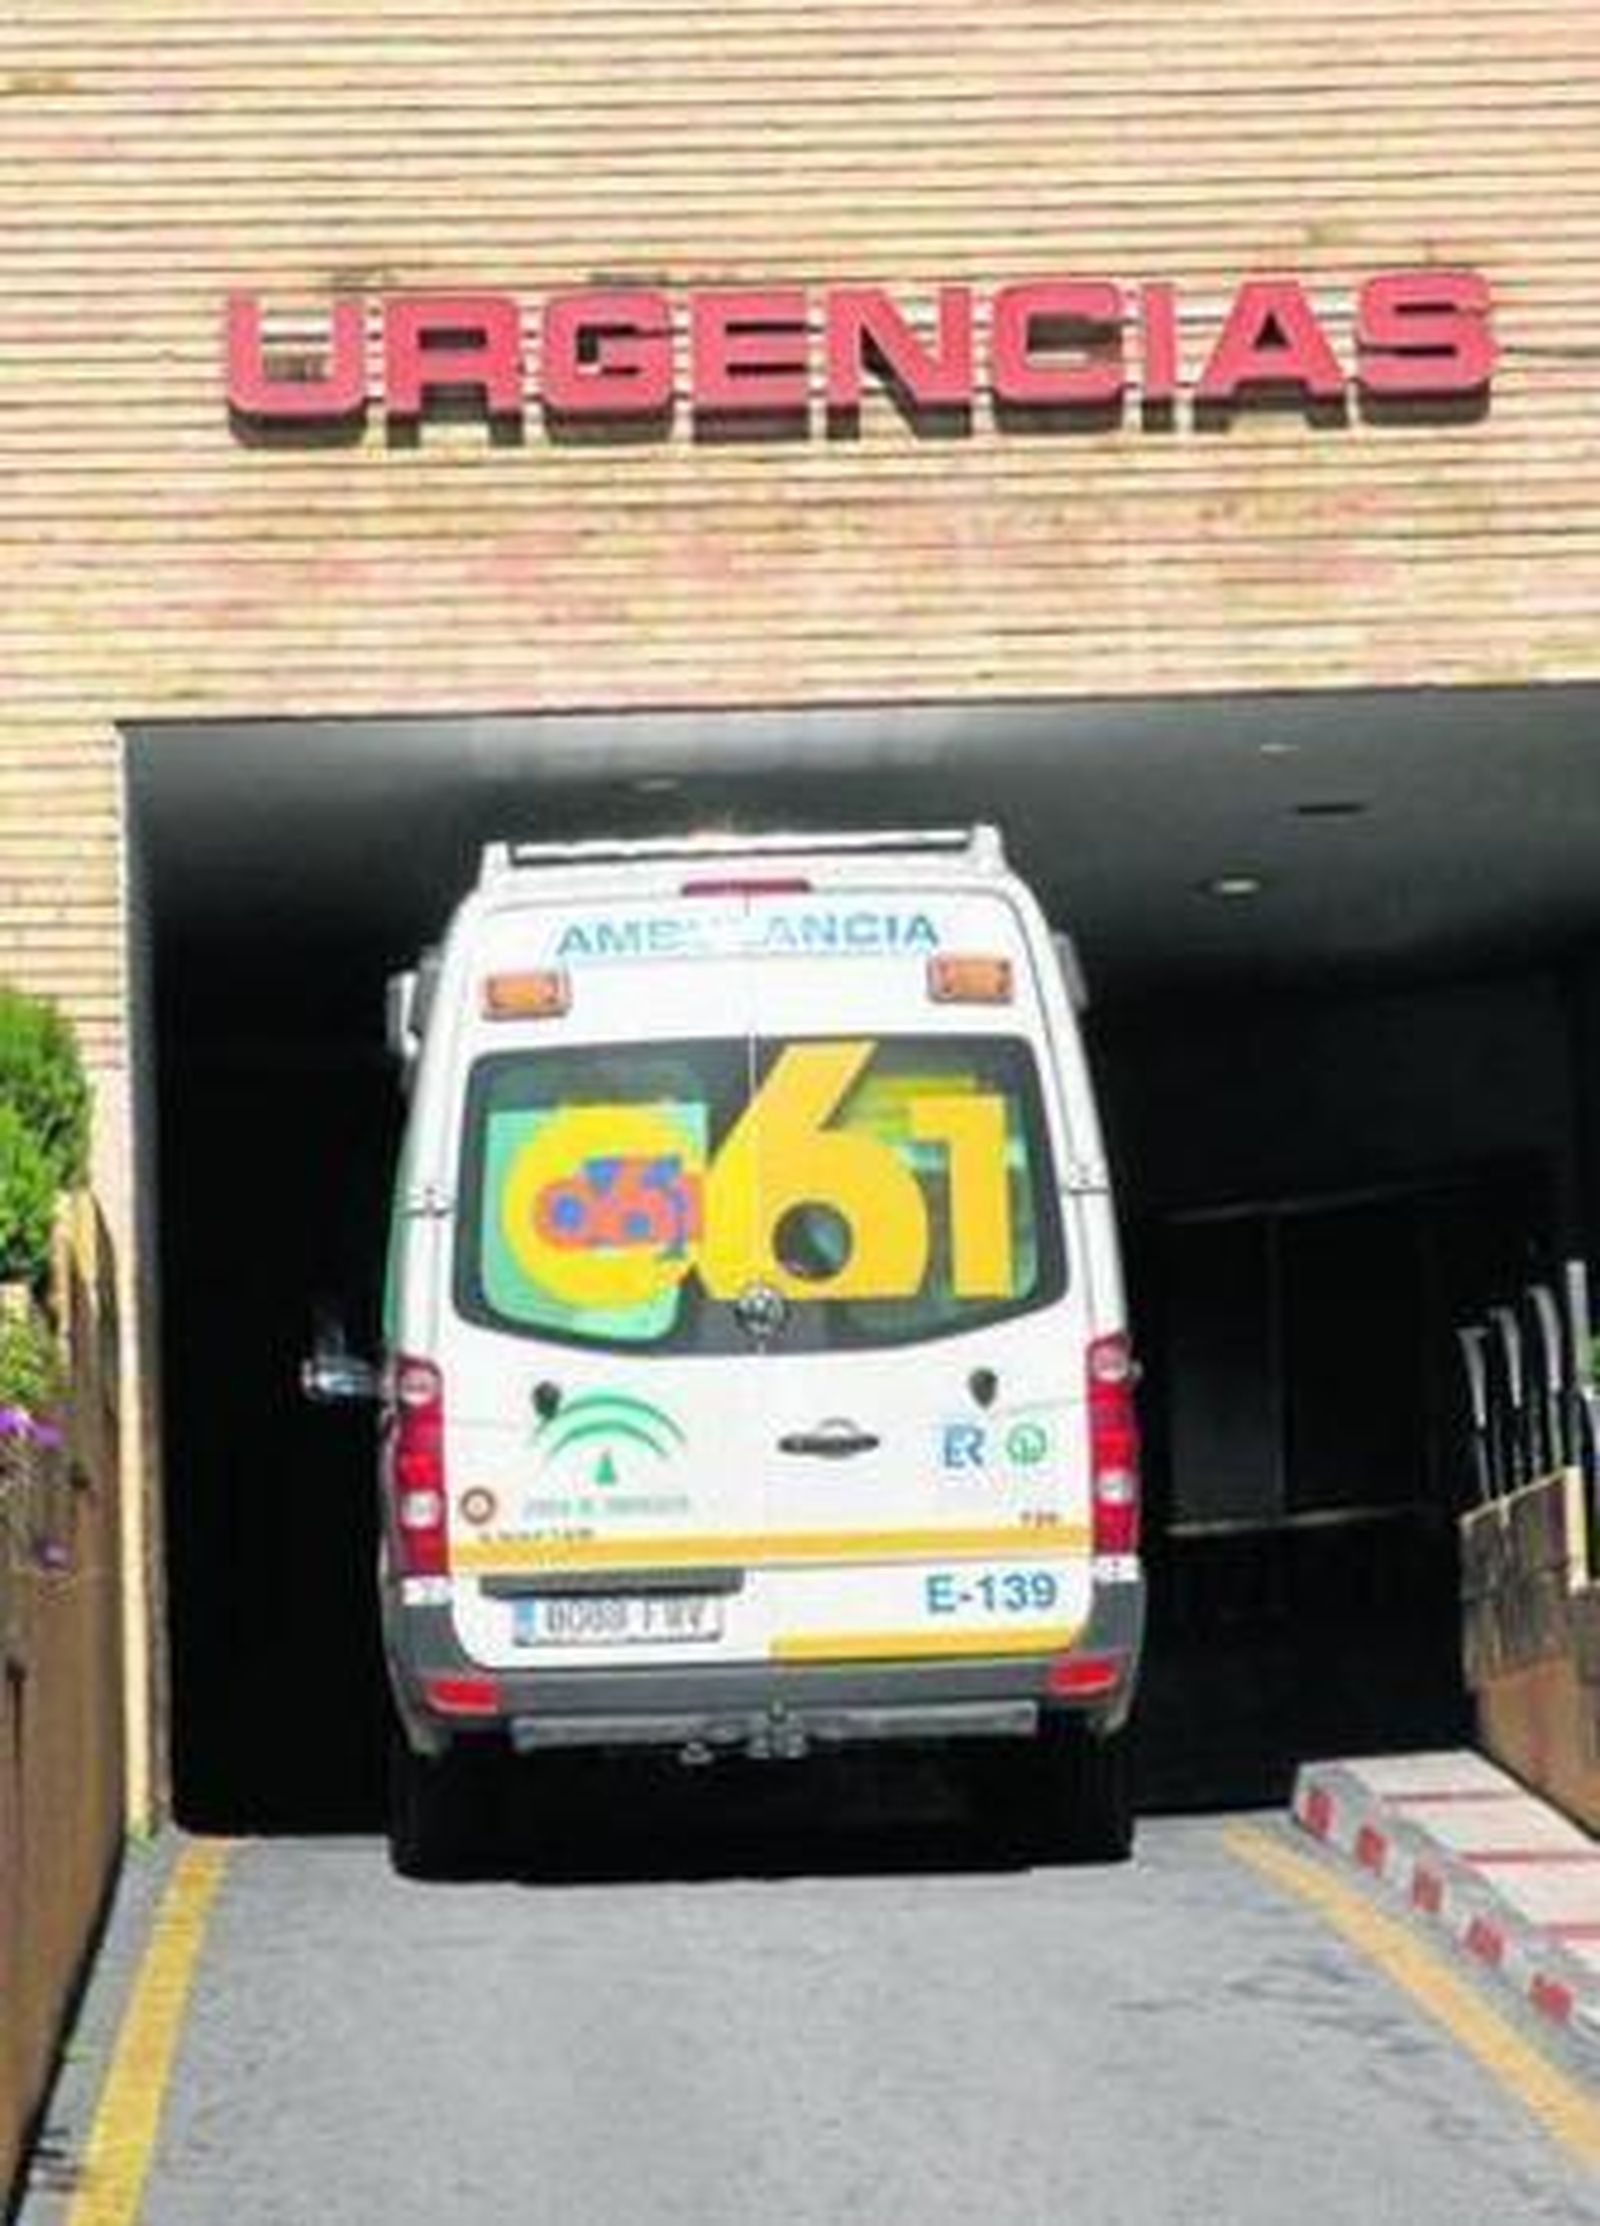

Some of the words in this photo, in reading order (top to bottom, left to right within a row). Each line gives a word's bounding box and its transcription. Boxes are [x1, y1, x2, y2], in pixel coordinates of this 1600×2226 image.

[228, 268, 1500, 424] URGENCIAS
[556, 911, 942, 956] AMBANCIA
[926, 1572, 1057, 1614] E-139
